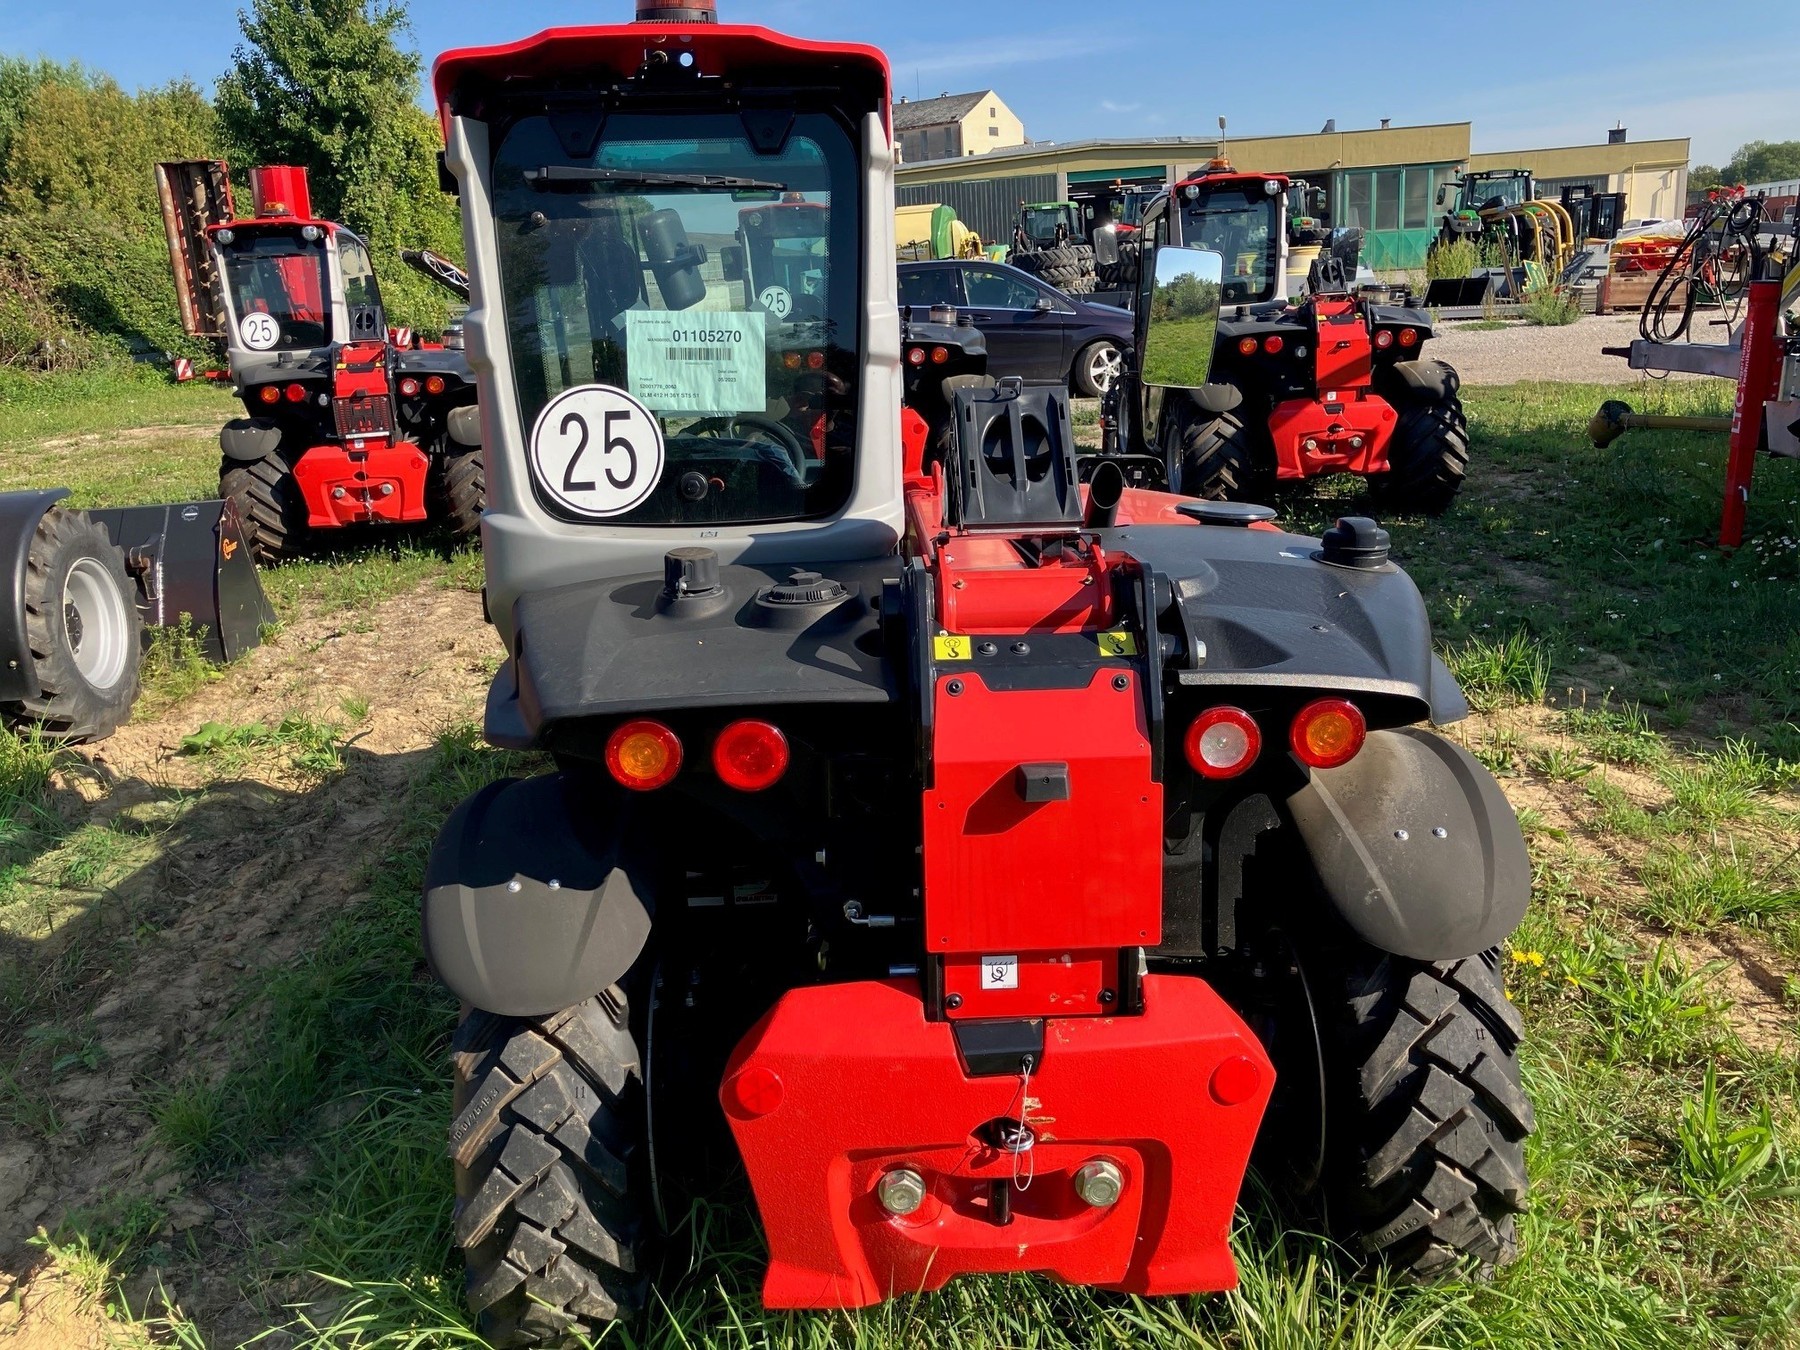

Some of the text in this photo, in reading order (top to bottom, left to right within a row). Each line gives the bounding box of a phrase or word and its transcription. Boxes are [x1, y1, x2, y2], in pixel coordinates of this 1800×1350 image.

[248, 319, 272, 342] 25
[672, 329, 742, 343] 01105270
[1741, 320, 1755, 388] TechnikCenter
[1731, 391, 1744, 434] LTC
[559, 410, 638, 492] 25
